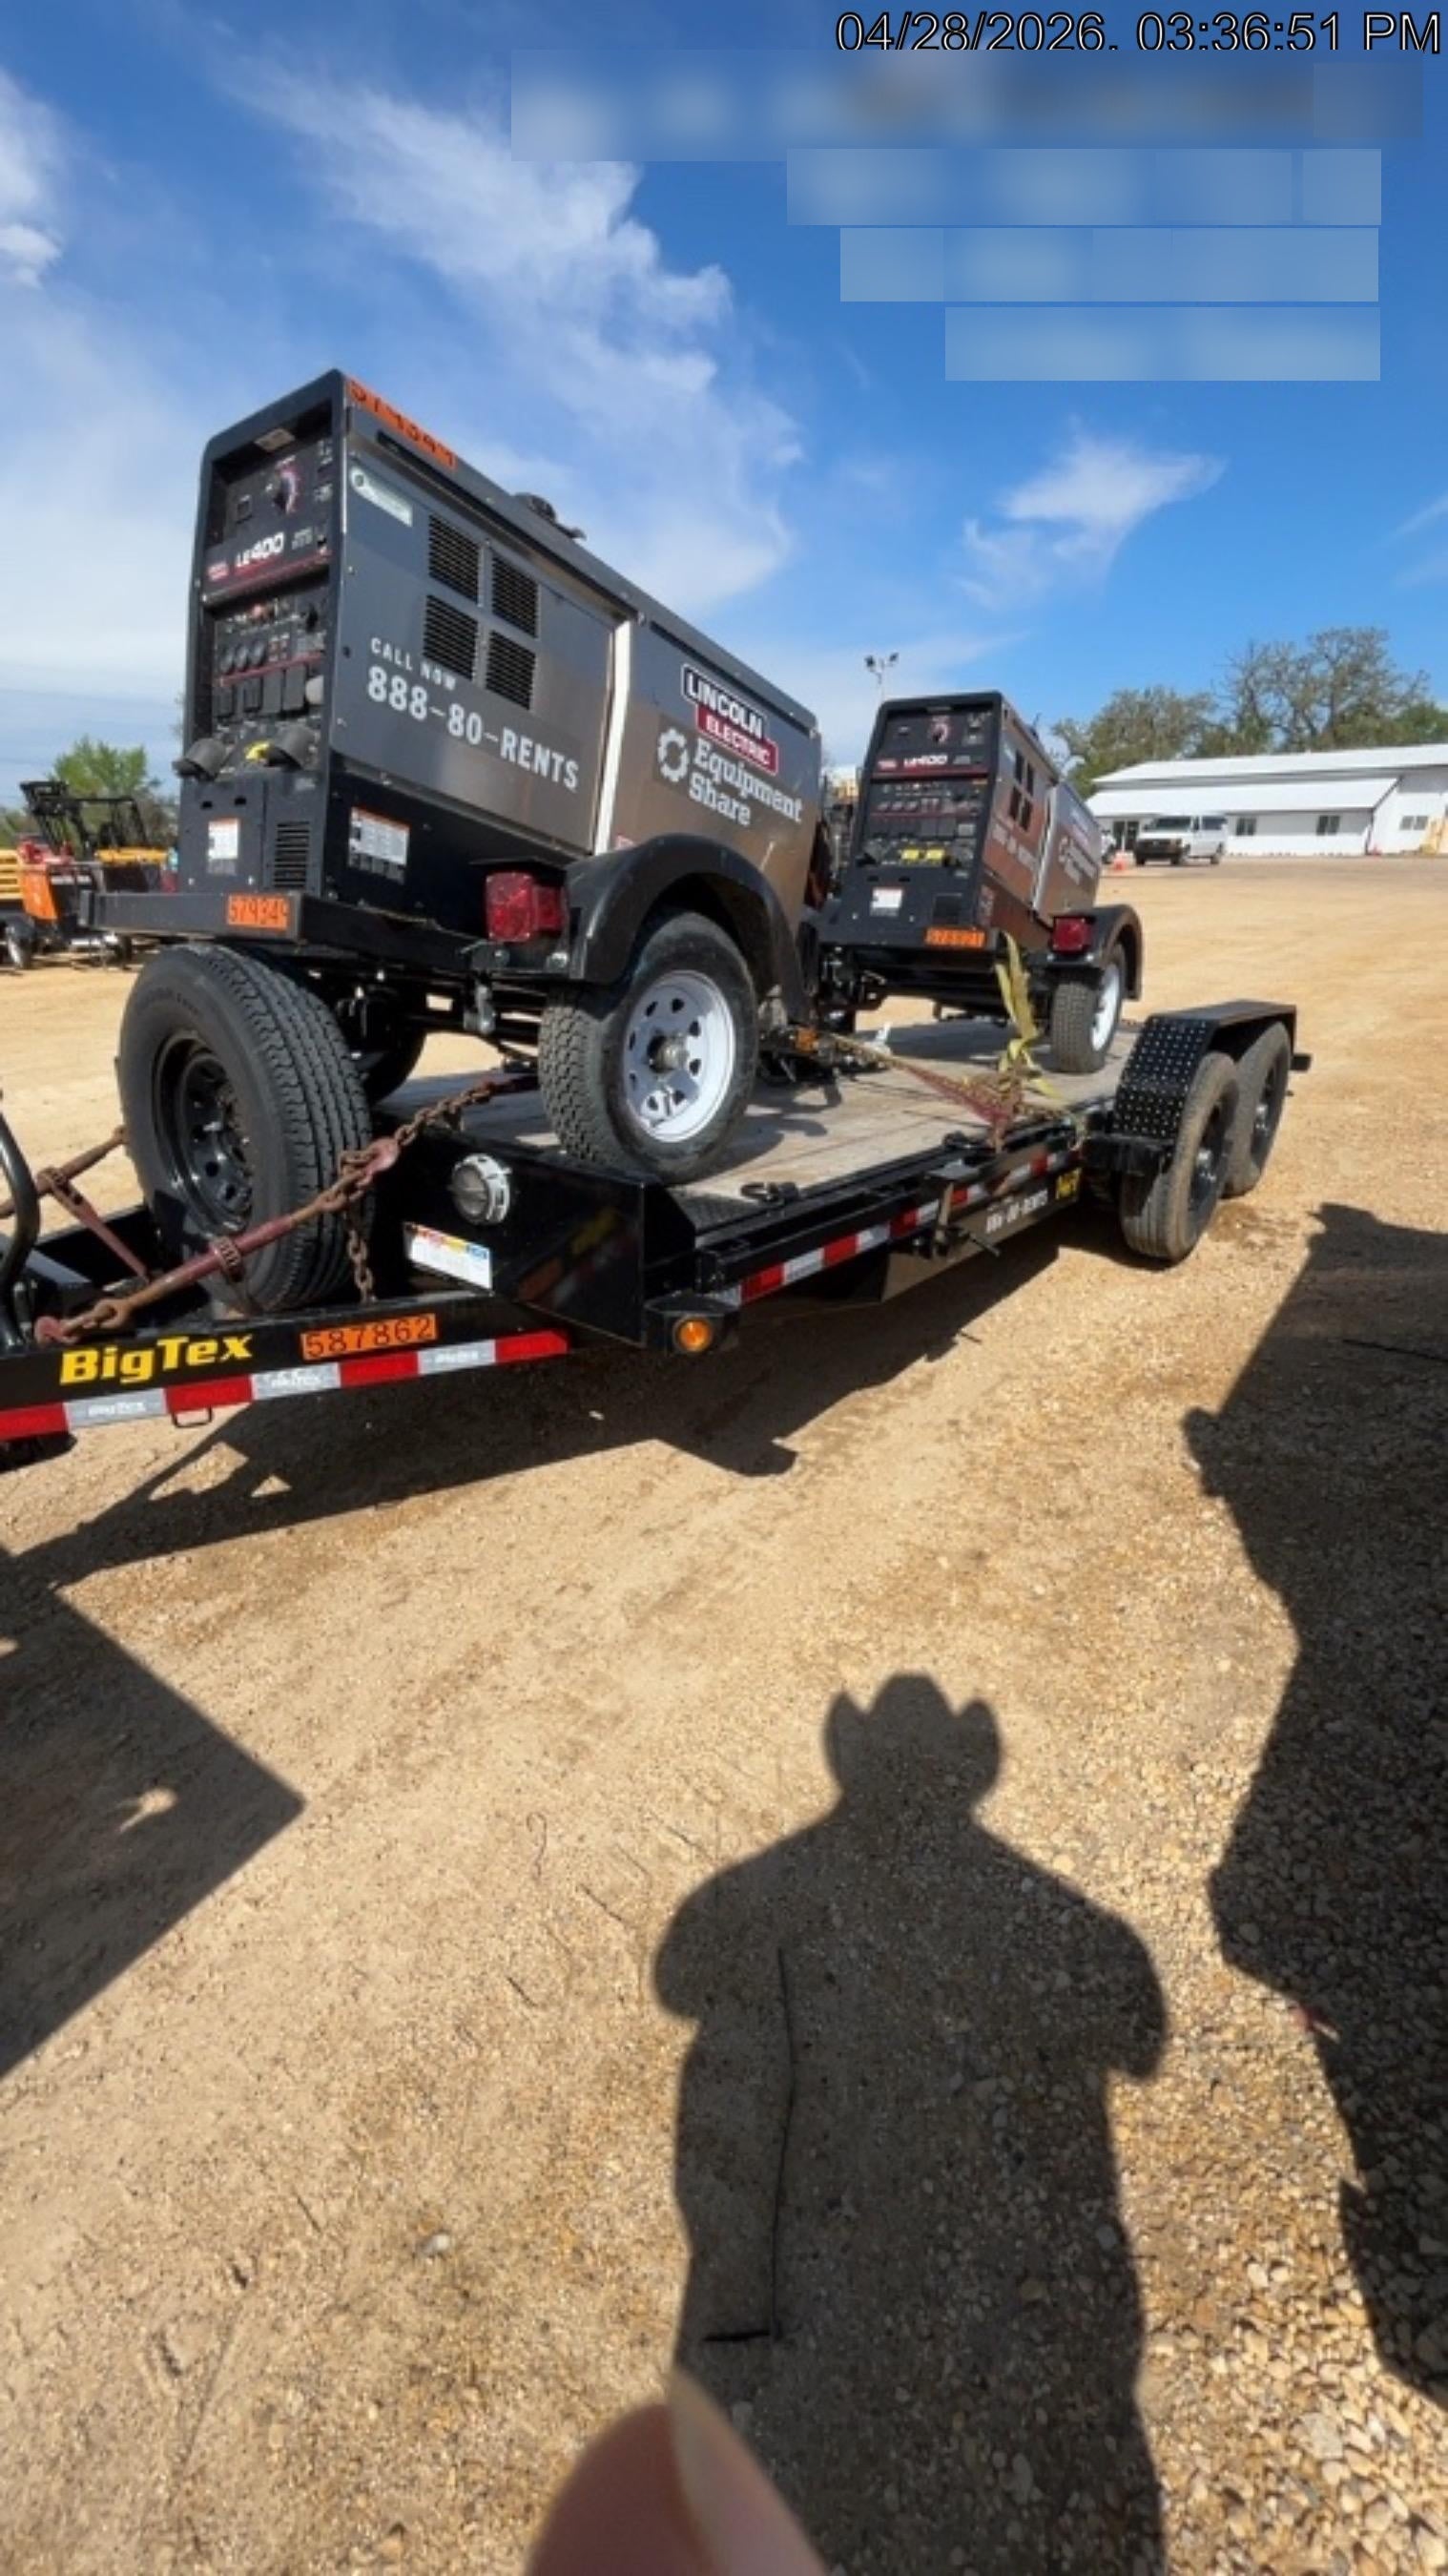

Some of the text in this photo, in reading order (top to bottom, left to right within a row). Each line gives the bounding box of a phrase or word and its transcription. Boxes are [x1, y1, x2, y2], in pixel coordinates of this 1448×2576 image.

[371, 636, 458, 691] CALL NOW
[367, 665, 580, 791] 888-80-RENTS
[687, 671, 764, 739] LINCOLN
[705, 714, 773, 765] ELECTRIC
[689, 771, 752, 827] Share
[693, 737, 803, 823] Equipment
[59, 1333, 253, 1386] BigTex
[305, 1316, 434, 1358] 587862
